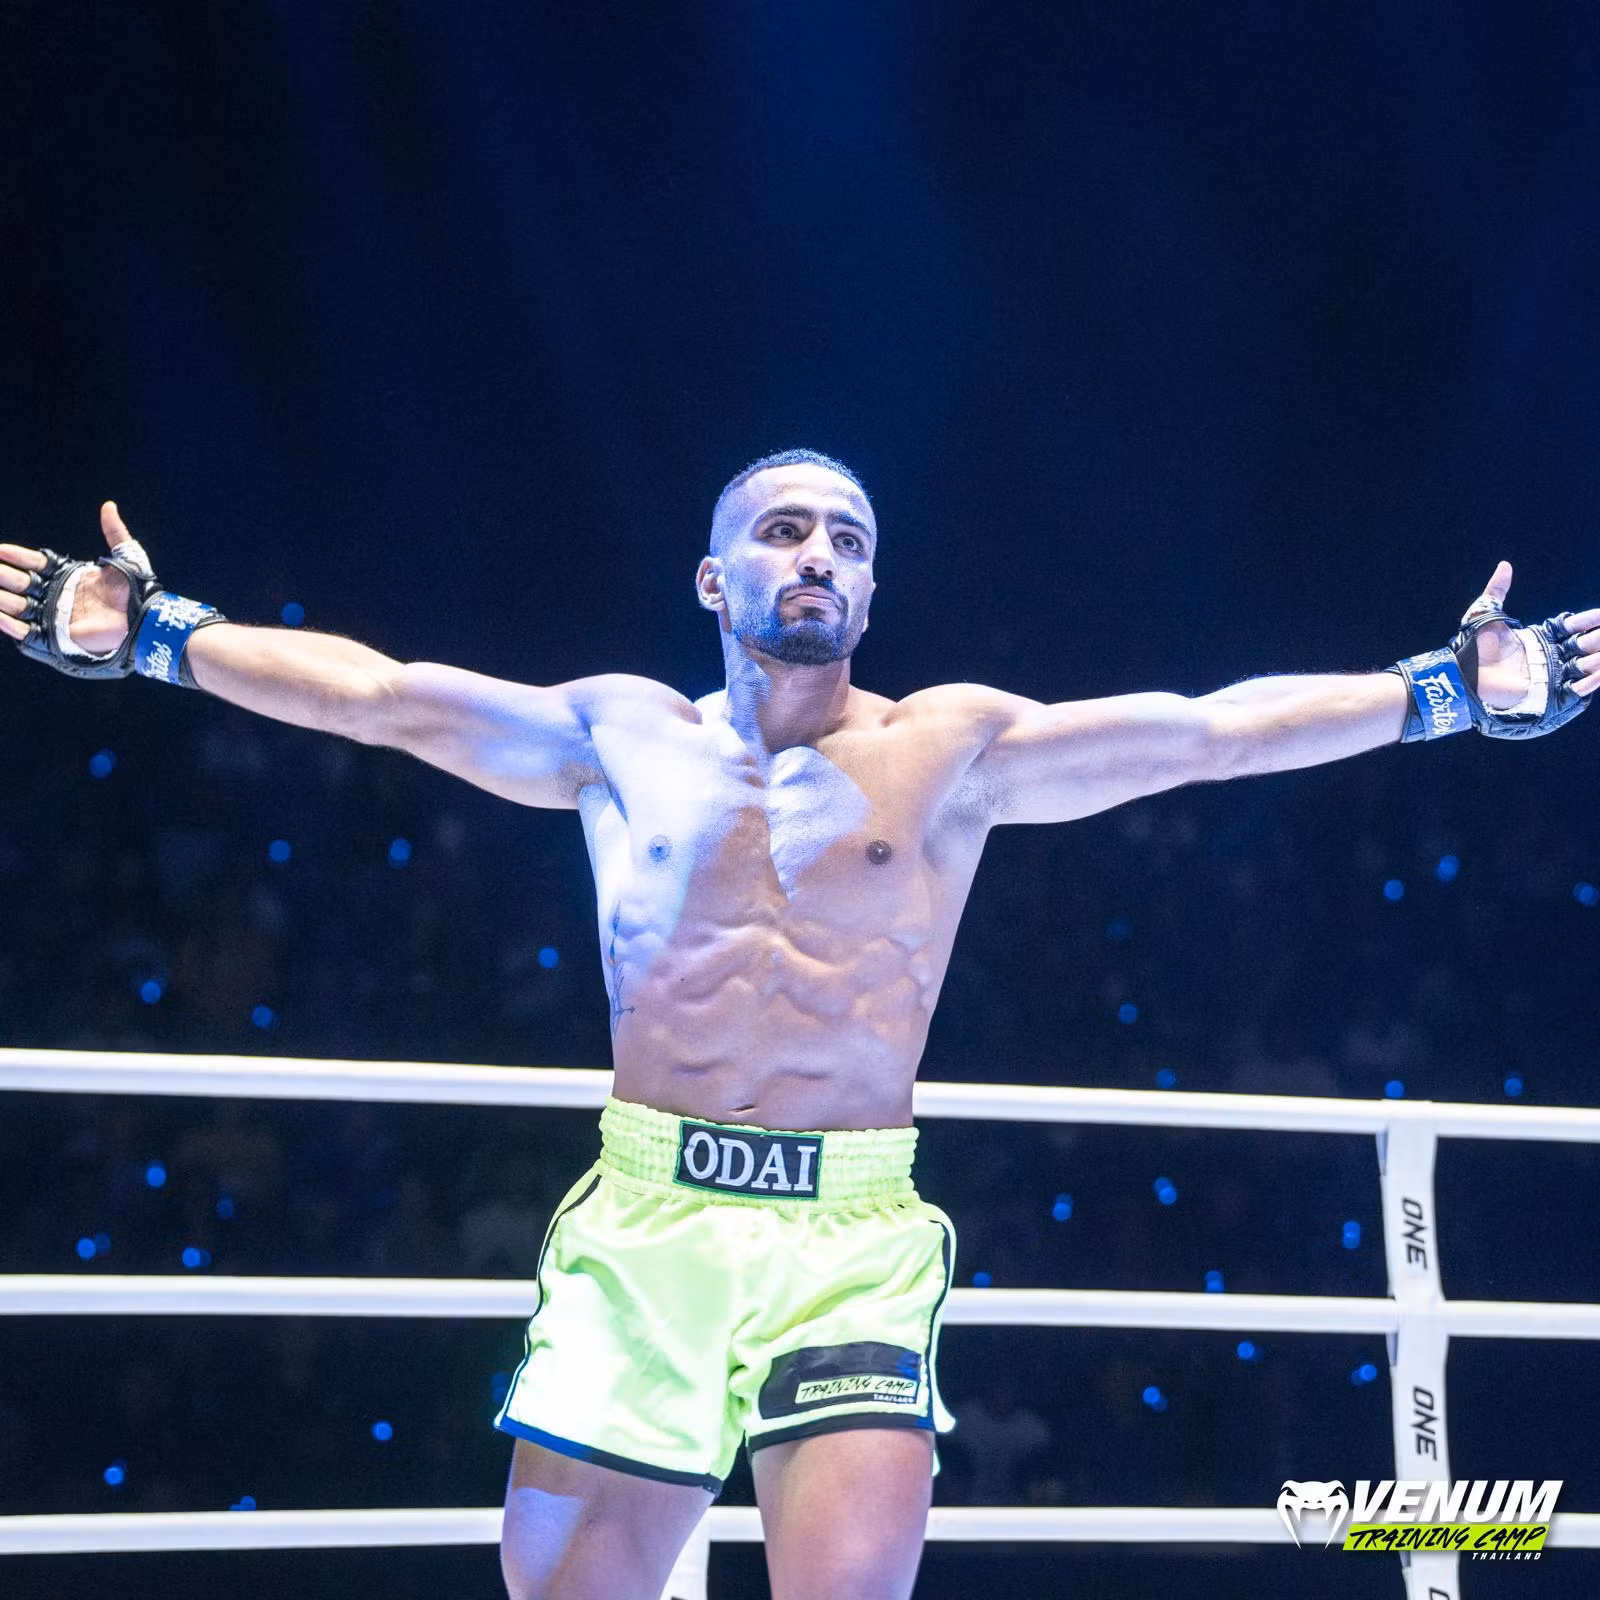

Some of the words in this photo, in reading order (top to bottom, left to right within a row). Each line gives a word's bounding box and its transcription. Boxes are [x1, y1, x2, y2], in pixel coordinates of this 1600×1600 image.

[1414, 672, 1460, 735] Fairtex
[684, 1131, 817, 1191] ODAI
[1401, 1196, 1428, 1271] ONE
[801, 1376, 872, 1399] TRAINING
[875, 1379, 915, 1394] CAMP
[1411, 1386, 1439, 1462] ONE
